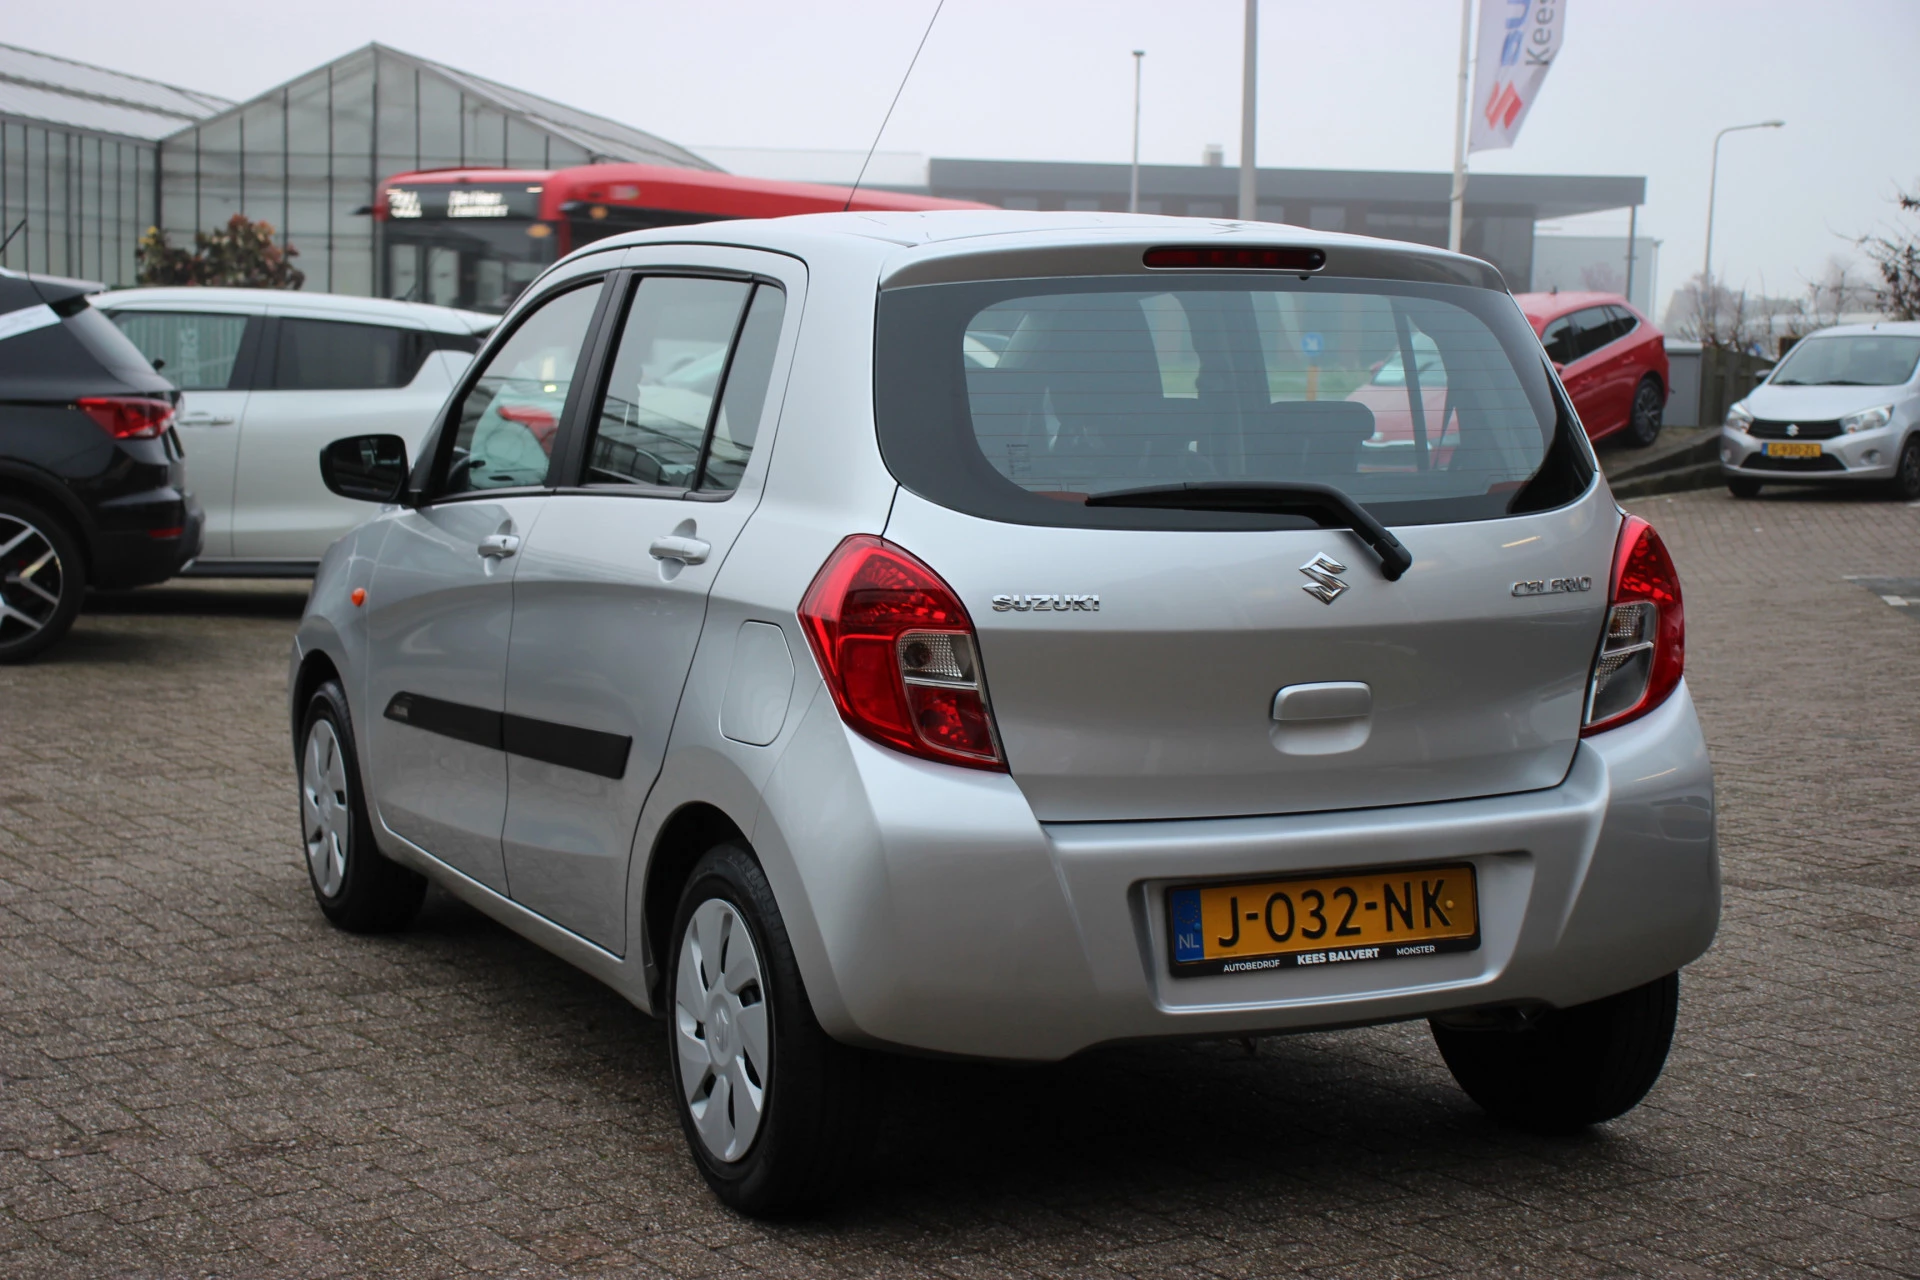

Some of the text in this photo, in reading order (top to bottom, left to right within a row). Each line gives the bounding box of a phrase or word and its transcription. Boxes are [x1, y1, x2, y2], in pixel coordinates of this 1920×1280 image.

[992, 594, 1100, 612] SUZUKI
[1218, 879, 1452, 948] J-032-NK
[1178, 933, 1200, 949] NL
[1223, 945, 1435, 973] AUTOBEDRIJF KEES BALVERT MONSTER
